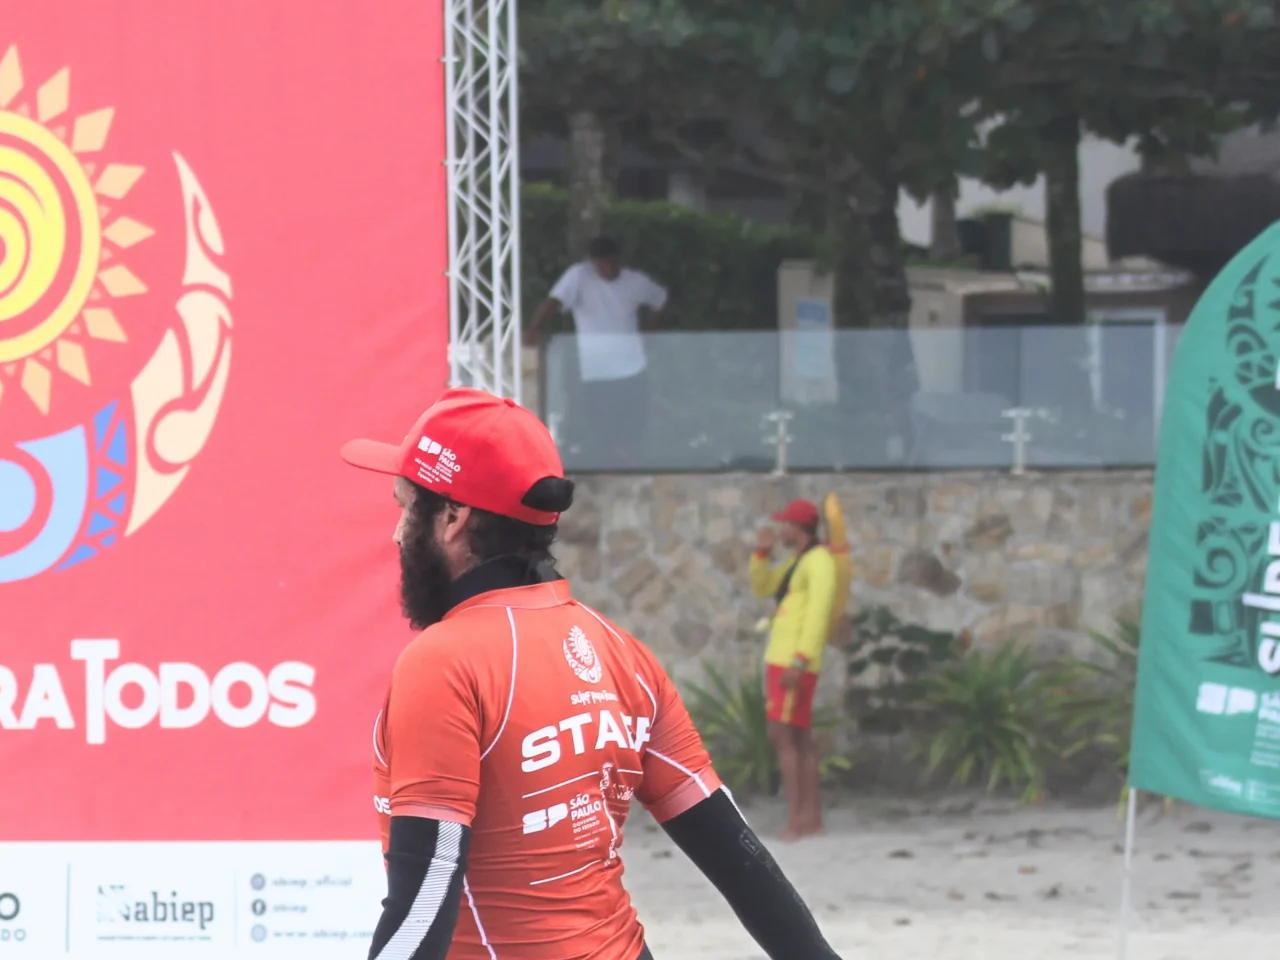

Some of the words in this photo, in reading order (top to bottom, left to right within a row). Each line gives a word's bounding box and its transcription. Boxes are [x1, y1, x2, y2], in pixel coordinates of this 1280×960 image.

[71, 638, 317, 744] TODOS
[570, 793, 590, 810] SÃO
[570, 801, 601, 821] PAULO
